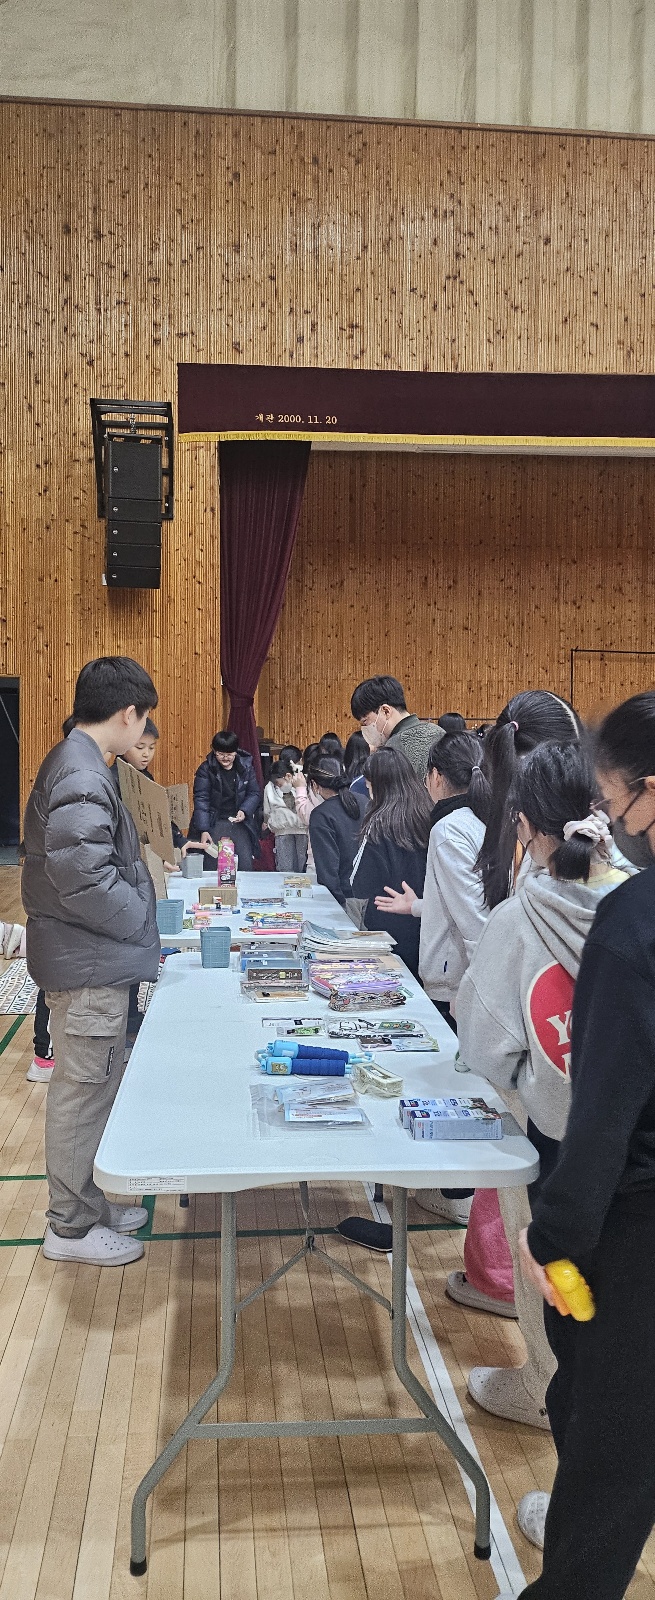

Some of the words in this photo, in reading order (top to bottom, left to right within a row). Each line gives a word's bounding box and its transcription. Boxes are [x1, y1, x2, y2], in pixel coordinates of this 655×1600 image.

[255, 413, 274, 423] 개관
[278, 414, 304, 424] 2000.
[308, 415, 322, 424] 11.
[325, 415, 337, 424] 20
[546, 1009, 573, 1046] Y
